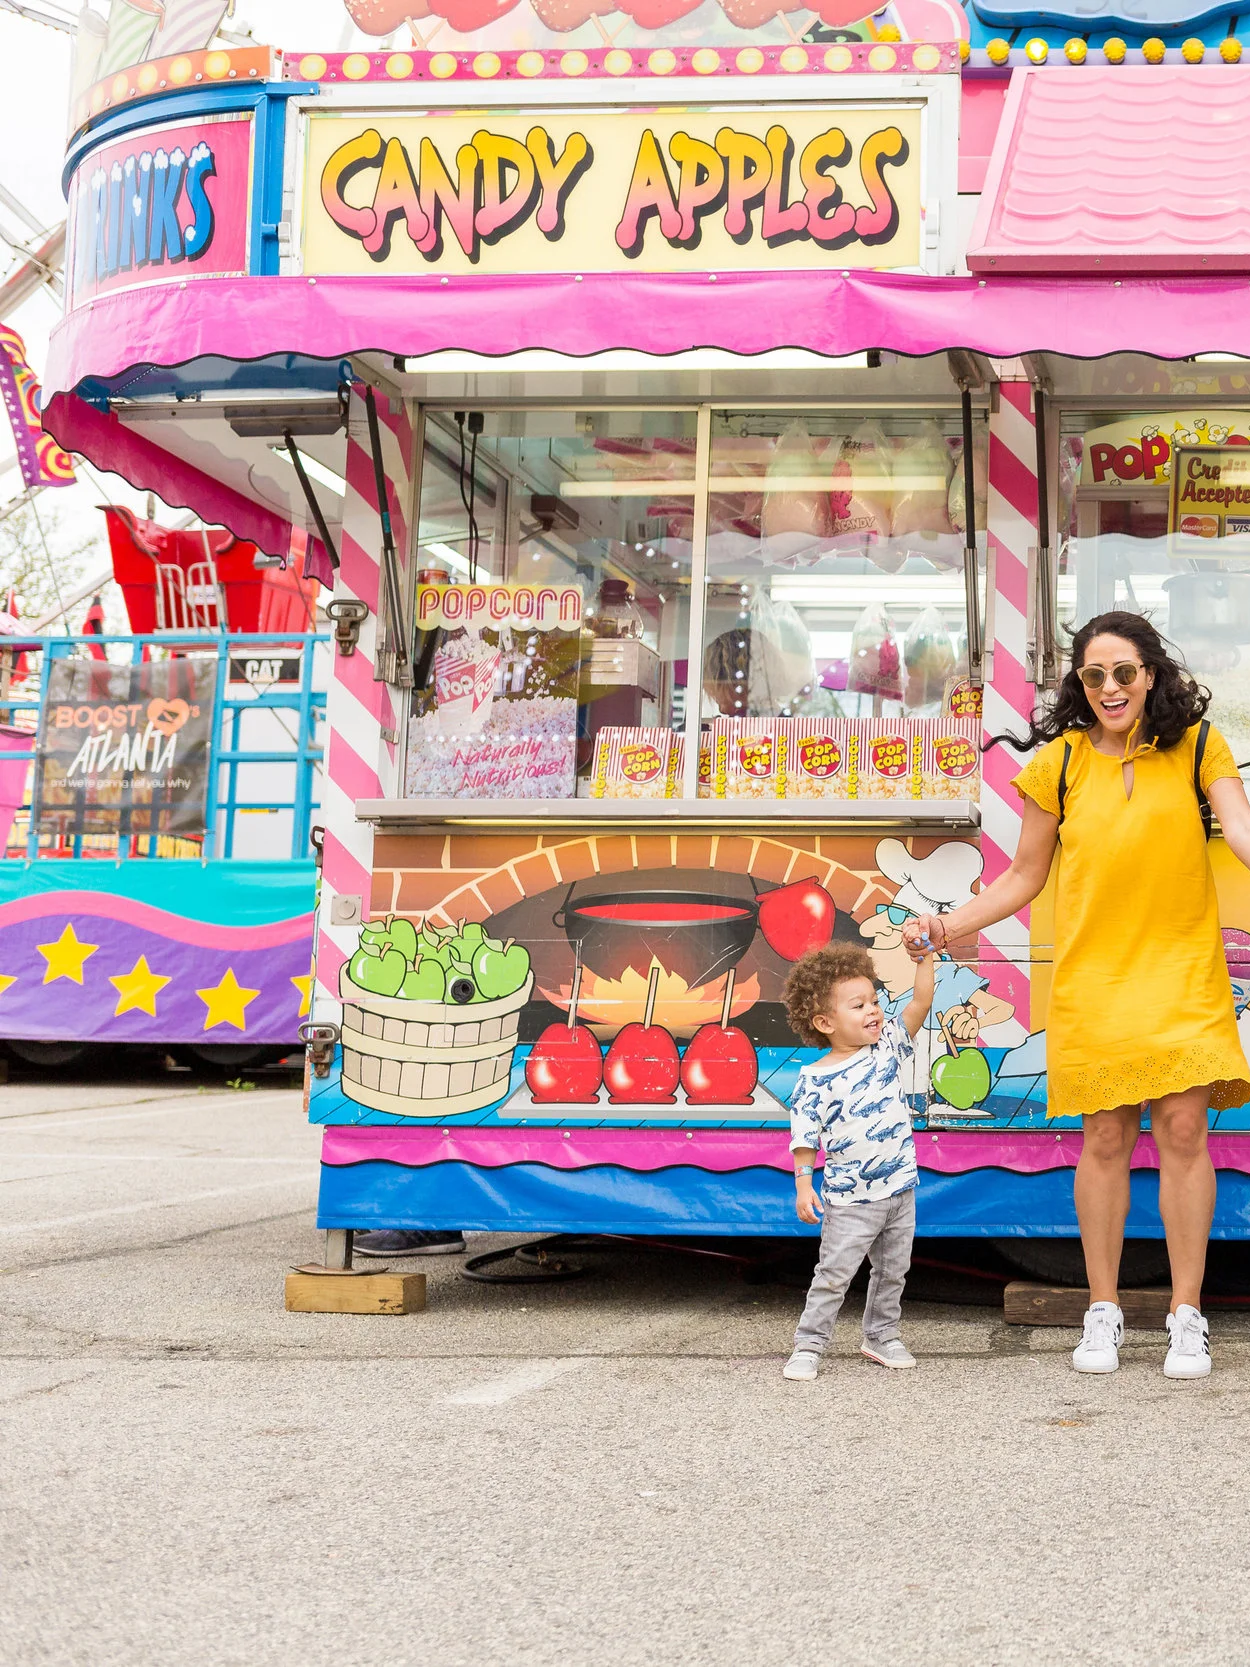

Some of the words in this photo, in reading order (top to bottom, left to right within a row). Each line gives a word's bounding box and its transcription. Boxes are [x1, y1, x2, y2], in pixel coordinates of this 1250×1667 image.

[320, 126, 594, 263] CANDY
[615, 125, 910, 259] APPLES
[1090, 435, 1170, 482] POP
[1181, 523, 1217, 532] MasterCard
[245, 660, 283, 682] CAT
[951, 690, 983, 705] ORN
[56, 704, 143, 729] BOOST
[67, 721, 177, 777] ATLANTA
[452, 737, 542, 767] Naturally
[626, 751, 655, 764] POP
[805, 743, 833, 757] POP
[877, 743, 905, 757] POP
[941, 743, 969, 757] POP
[623, 759, 661, 776] CORN
[742, 753, 772, 770] COR
[803, 752, 841, 770] CORN
[938, 752, 976, 770] CORN
[459, 755, 567, 790] Nutritious!
[595, 743, 610, 799] POPCOR
[665, 748, 679, 799] POPCOR
[168, 777, 191, 791] why
